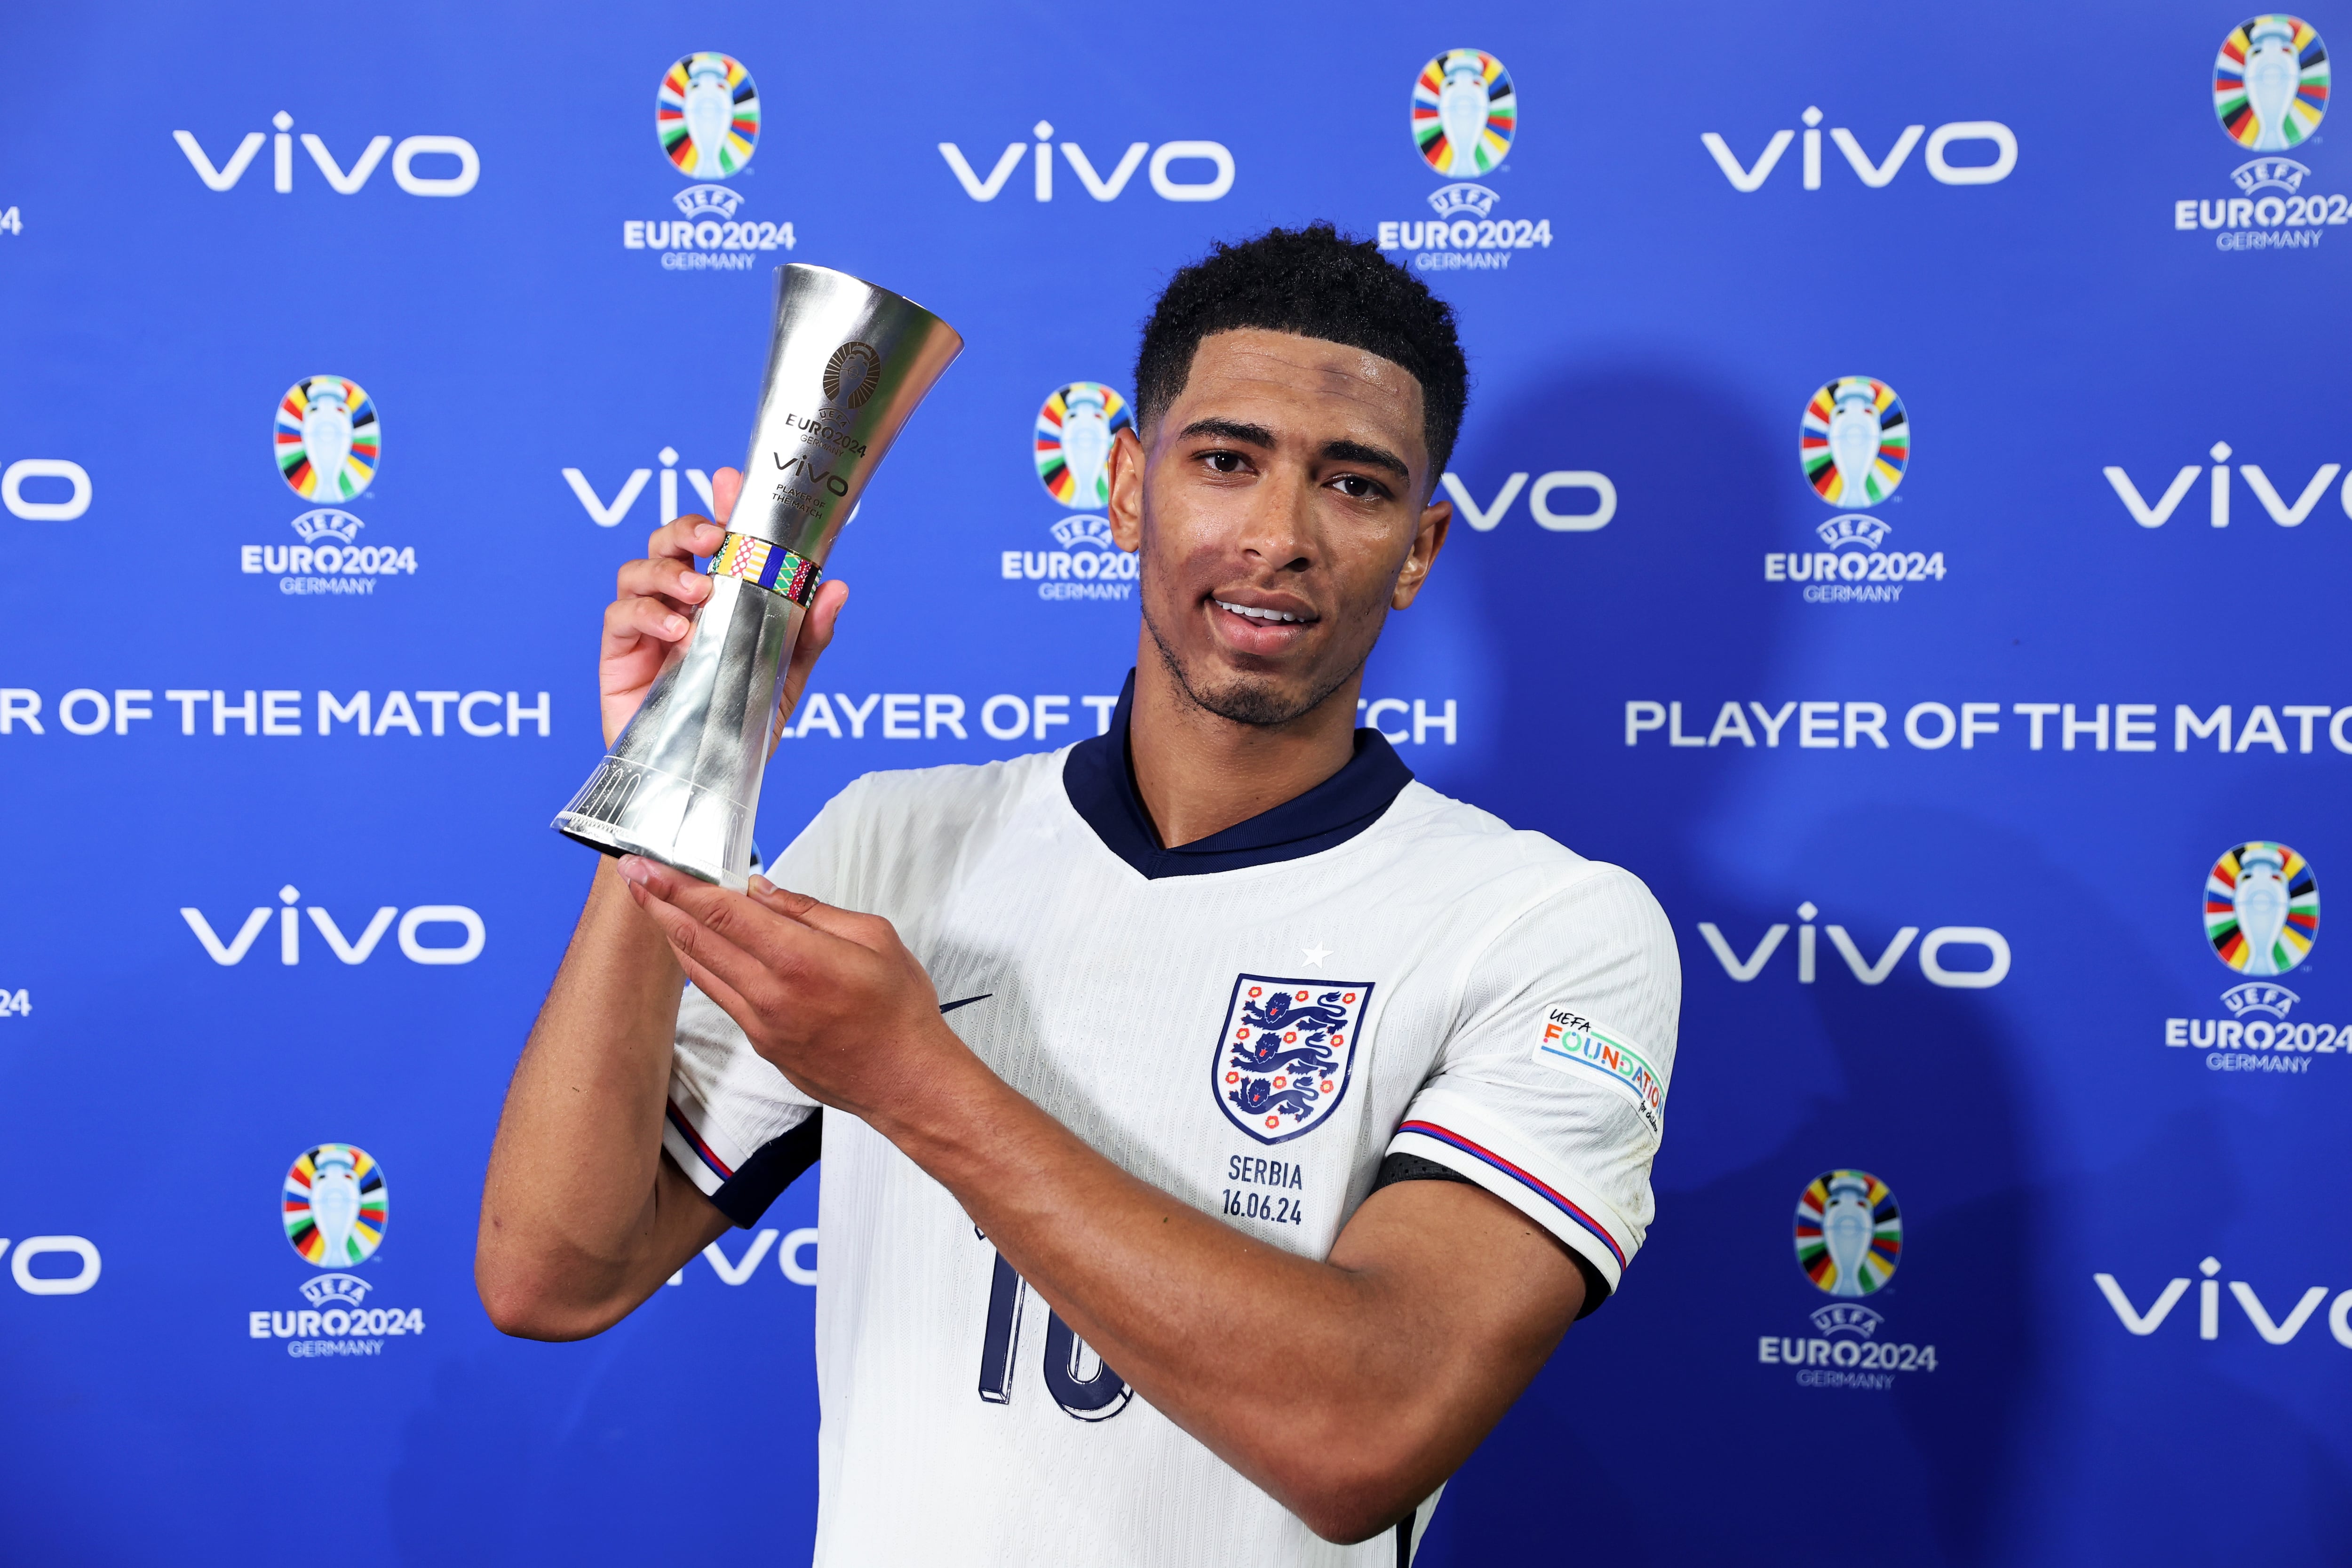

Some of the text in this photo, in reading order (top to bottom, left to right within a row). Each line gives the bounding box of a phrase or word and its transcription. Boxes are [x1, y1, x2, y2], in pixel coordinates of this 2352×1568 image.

[173, 111, 480, 196] vivo
[938, 120, 1235, 201] vivo
[1701, 106, 2018, 192] vivo
[2233, 161, 2306, 192] UEFA
[675, 187, 740, 216] UEFA
[1429, 186, 1496, 216] UEFA
[2175, 195, 2352, 231] EURO202
[625, 221, 795, 251] EURO2024
[1378, 219, 1553, 249] EURO2024
[2216, 230, 2323, 250] GERMANY
[661, 253, 755, 270] GERMANY
[1415, 252, 1510, 270] GERMANY
[820, 410, 847, 428] UEFA
[785, 413, 867, 458] EURO2024
[801, 435, 844, 456] GERMANY
[774, 452, 848, 497] vivo
[2104, 441, 2352, 528] viv
[772, 493, 823, 519] THE MATCH
[777, 484, 826, 509] PLAYER OF
[293, 515, 362, 541] UEFA
[1052, 517, 1112, 546] UEFA
[1819, 519, 1888, 548] UEFA
[241, 545, 417, 575] EURO2024
[1001, 551, 1140, 580] EURO20
[1765, 552, 1947, 581] EURO2024
[279, 576, 376, 594] GERMANY
[1039, 582, 1132, 600] GERMANY
[1803, 584, 1903, 602] GERMANY
[59, 689, 152, 735] OF
[166, 690, 301, 735] THE
[318, 691, 550, 736] MATCH
[981, 694, 1069, 740] OF
[1626, 701, 1889, 748] PLAYER
[1905, 702, 2000, 749] OF
[2013, 703, 2156, 751] THE
[181, 885, 485, 965] vivo
[1699, 902, 2011, 988] vivo
[2223, 986, 2296, 1017] UEFA
[1550, 1009, 1591, 1032] UEFA
[2205, 1052, 2312, 1073] GERMANY
[1228, 1155, 1302, 1190] SERBIA
[1223, 1189, 1301, 1225] 16.06.24
[302, 1276, 369, 1304] UEFA
[2094, 1257, 2352, 1349] viv
[249, 1309, 426, 1337] EURO2024
[1813, 1307, 1879, 1336] UEFA
[287, 1339, 383, 1357] GERMANY
[1758, 1337, 1939, 1371] EURO2024
[1796, 1369, 1896, 1389] GERMANY
